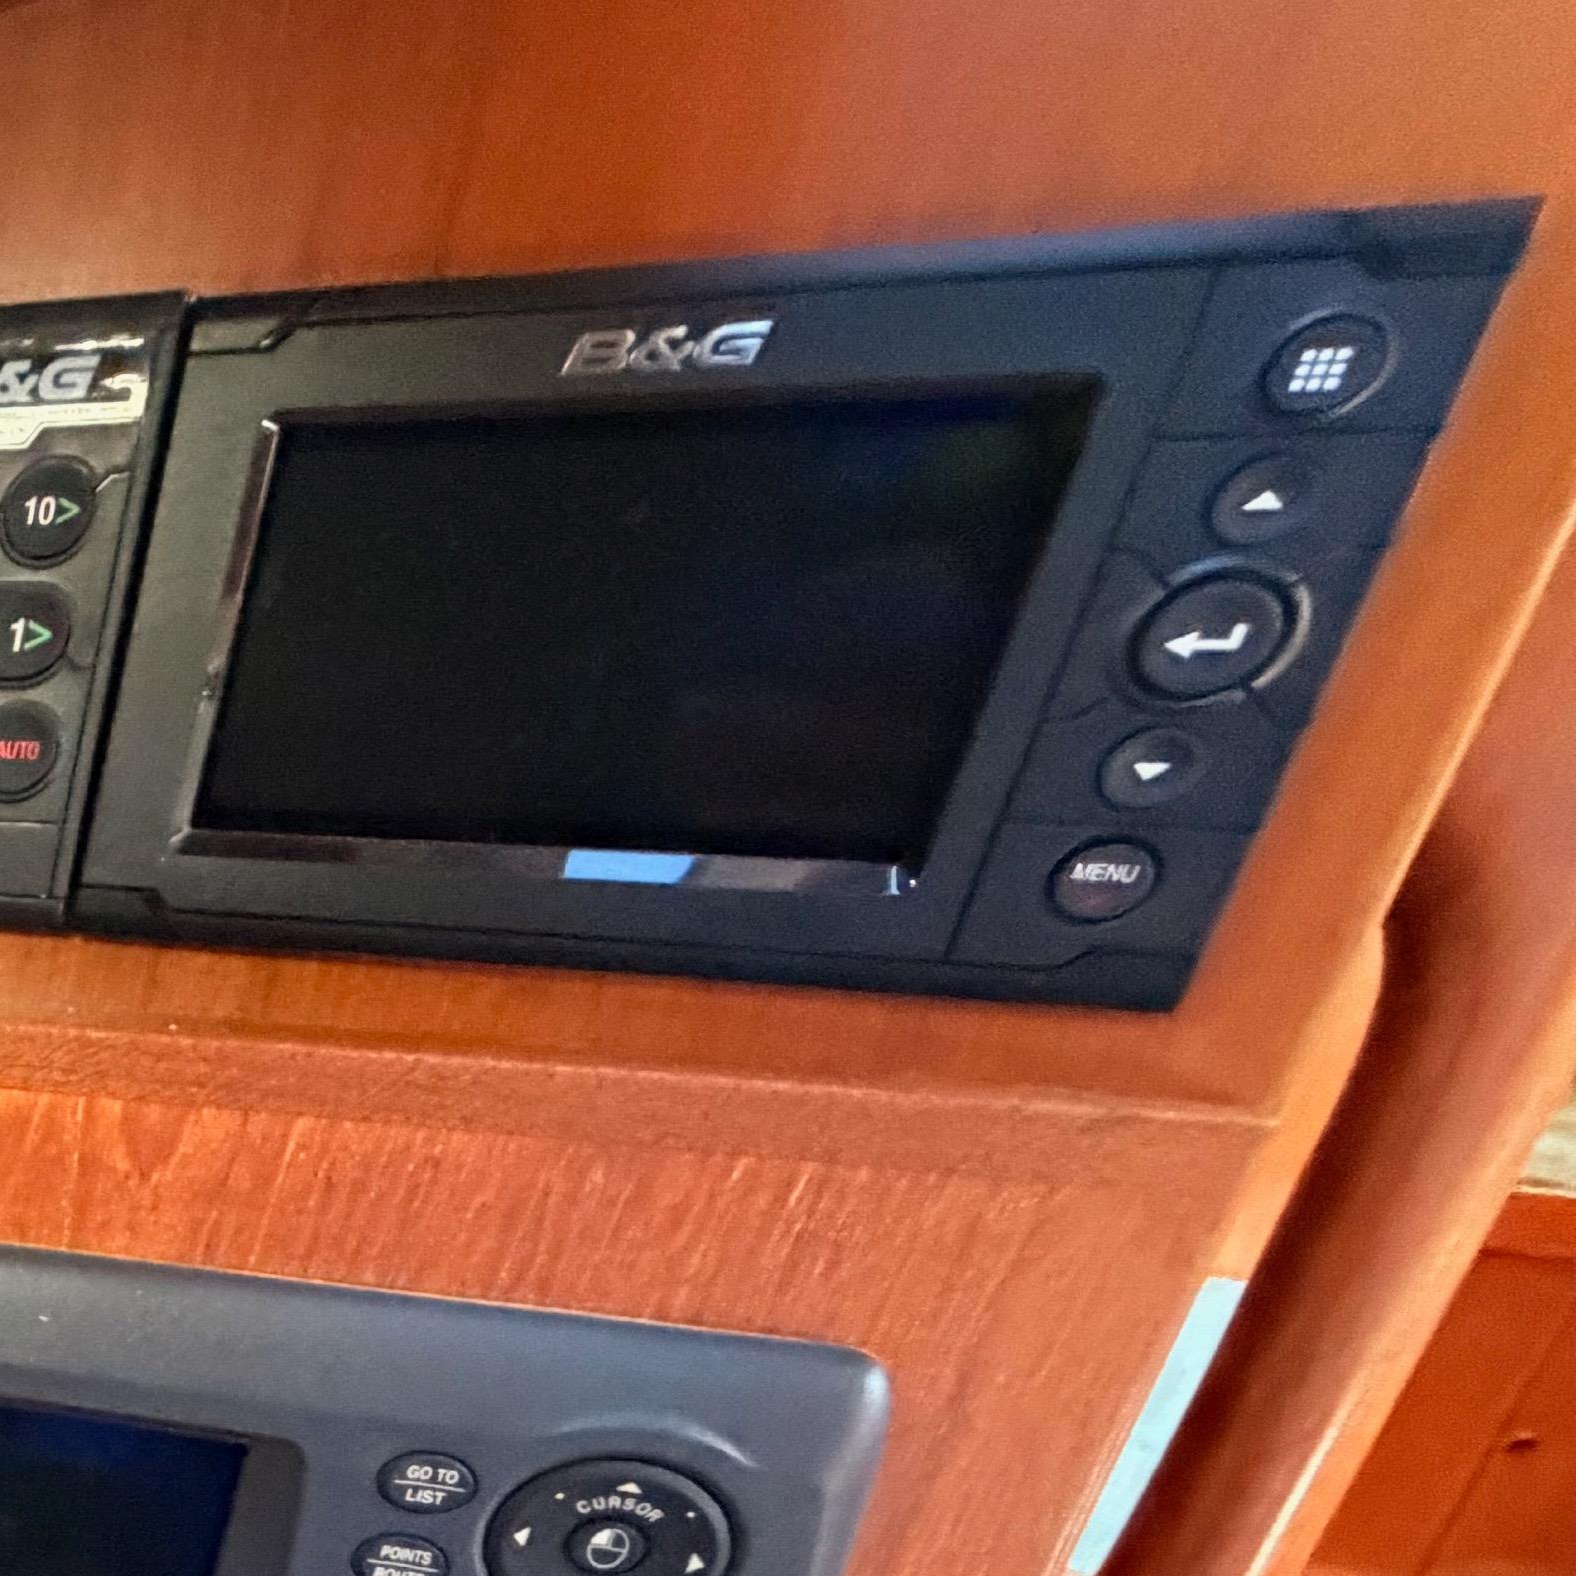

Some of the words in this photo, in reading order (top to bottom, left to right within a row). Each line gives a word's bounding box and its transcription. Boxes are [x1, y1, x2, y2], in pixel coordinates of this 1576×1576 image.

[560, 317, 774, 378] B&G
[1070, 860, 1140, 888] MENU
[407, 1465, 431, 1480] GO
[436, 1468, 460, 1484] TO
[405, 1488, 445, 1506] LIST
[575, 1495, 665, 1523] CURSOR
[379, 1545, 432, 1566] POINTS
